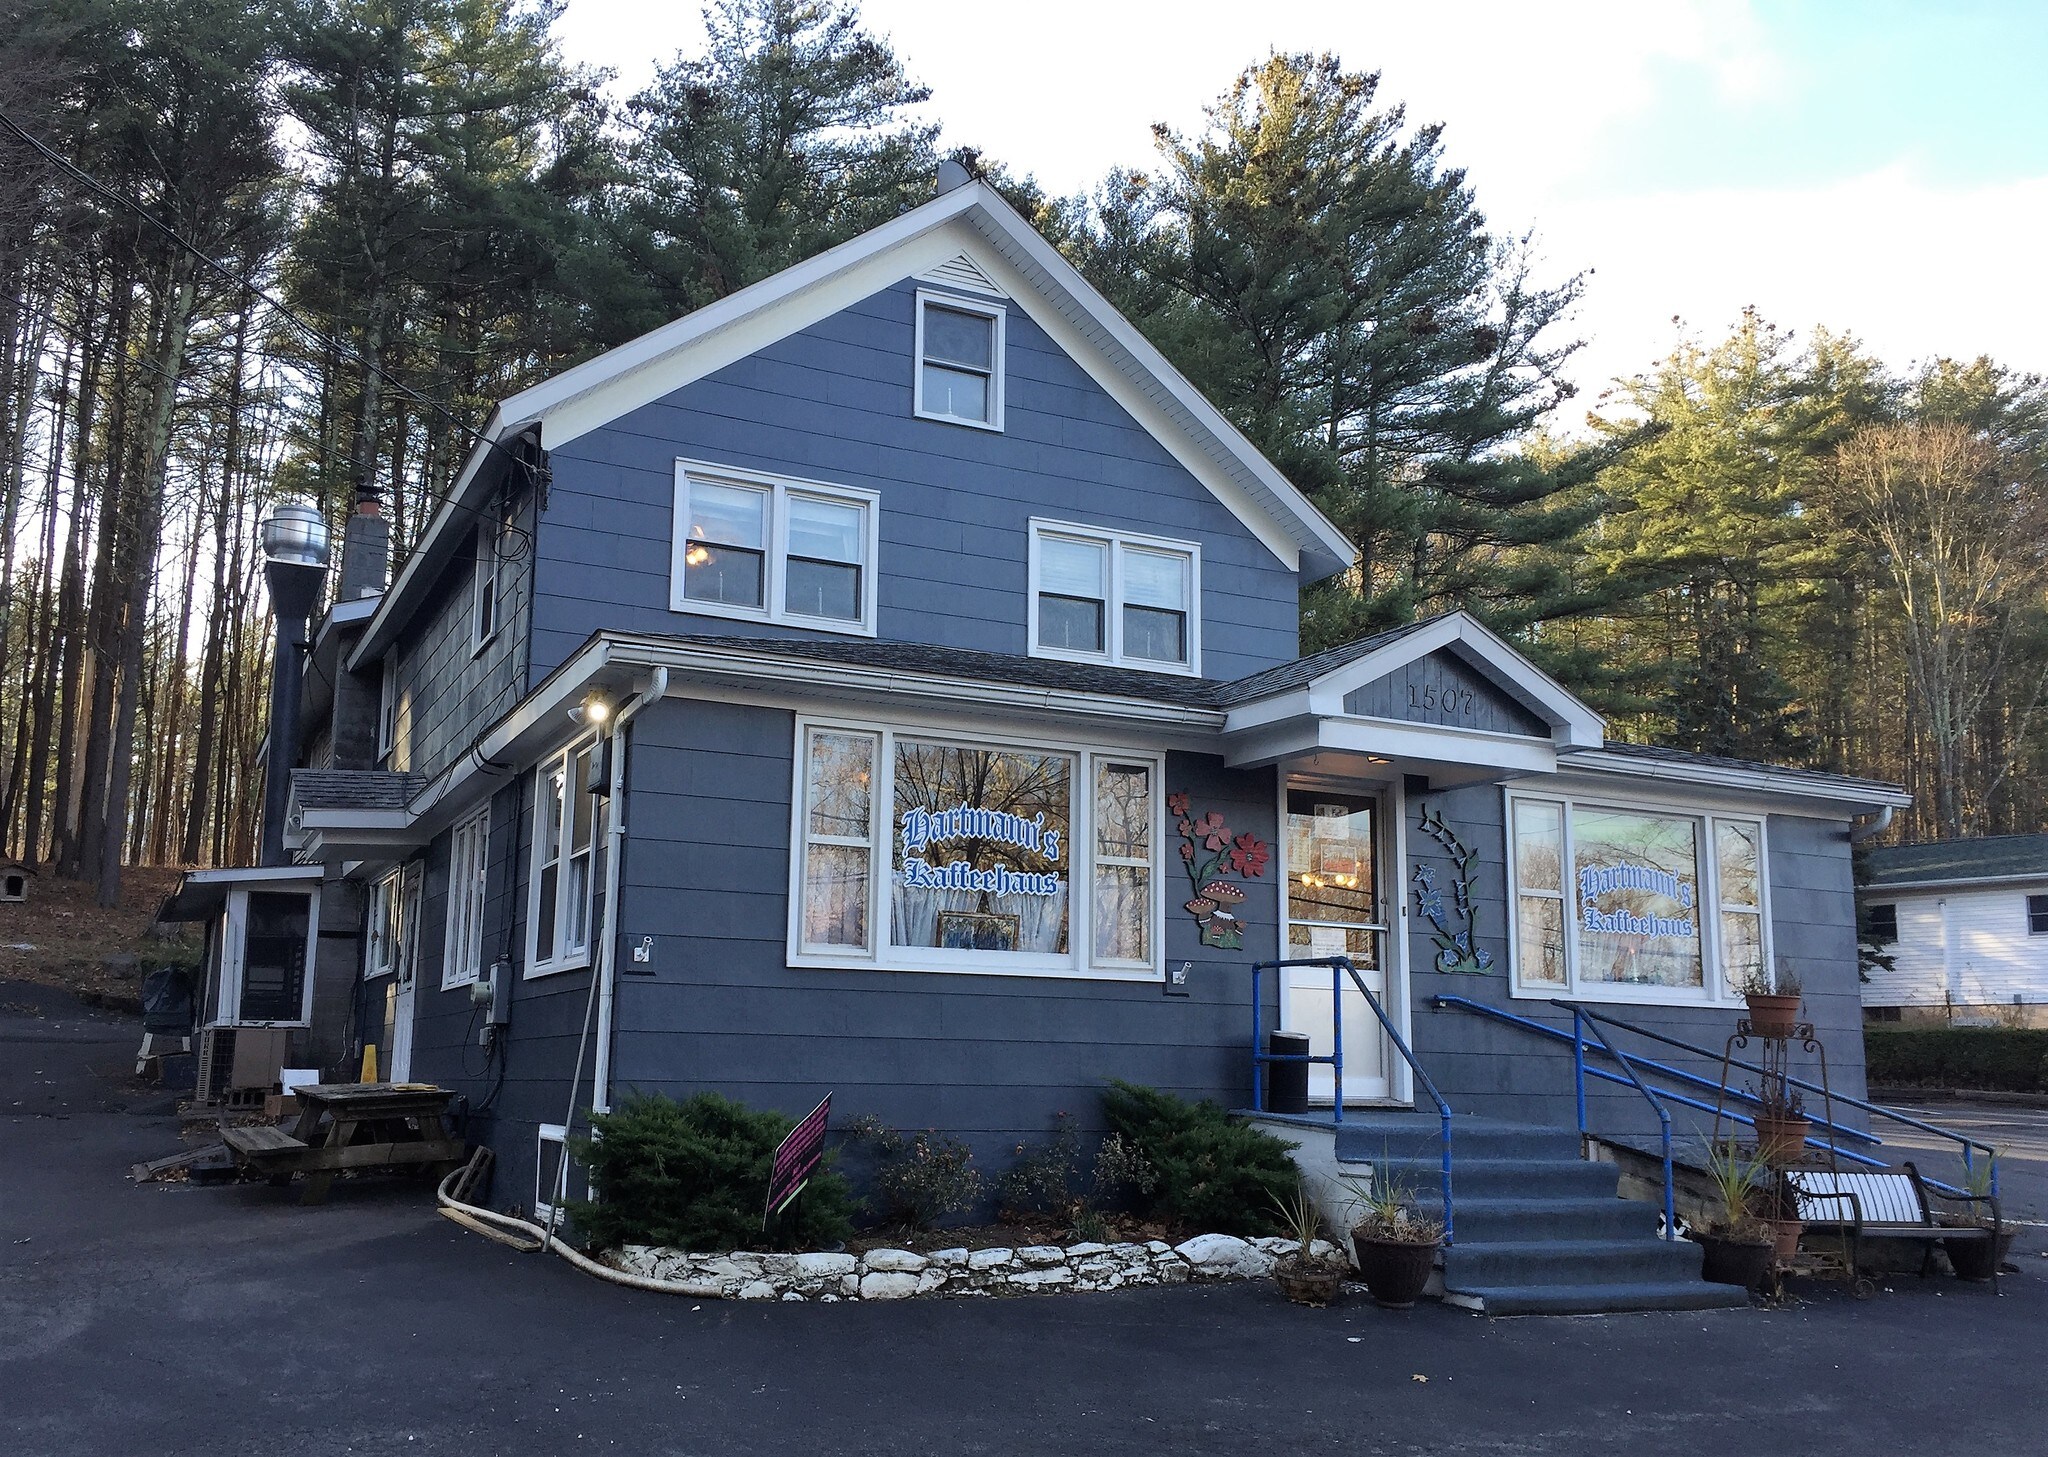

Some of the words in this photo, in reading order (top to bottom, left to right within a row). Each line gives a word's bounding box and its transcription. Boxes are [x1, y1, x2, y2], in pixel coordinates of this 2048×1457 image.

[1409, 684, 1473, 715] 1507
[901, 801, 1059, 861] Hartmann's
[904, 858, 1059, 897] Kaffeehaus
[1580, 860, 1692, 907] Hartmann's
[1583, 907, 1693, 940] Kaffeehaus
